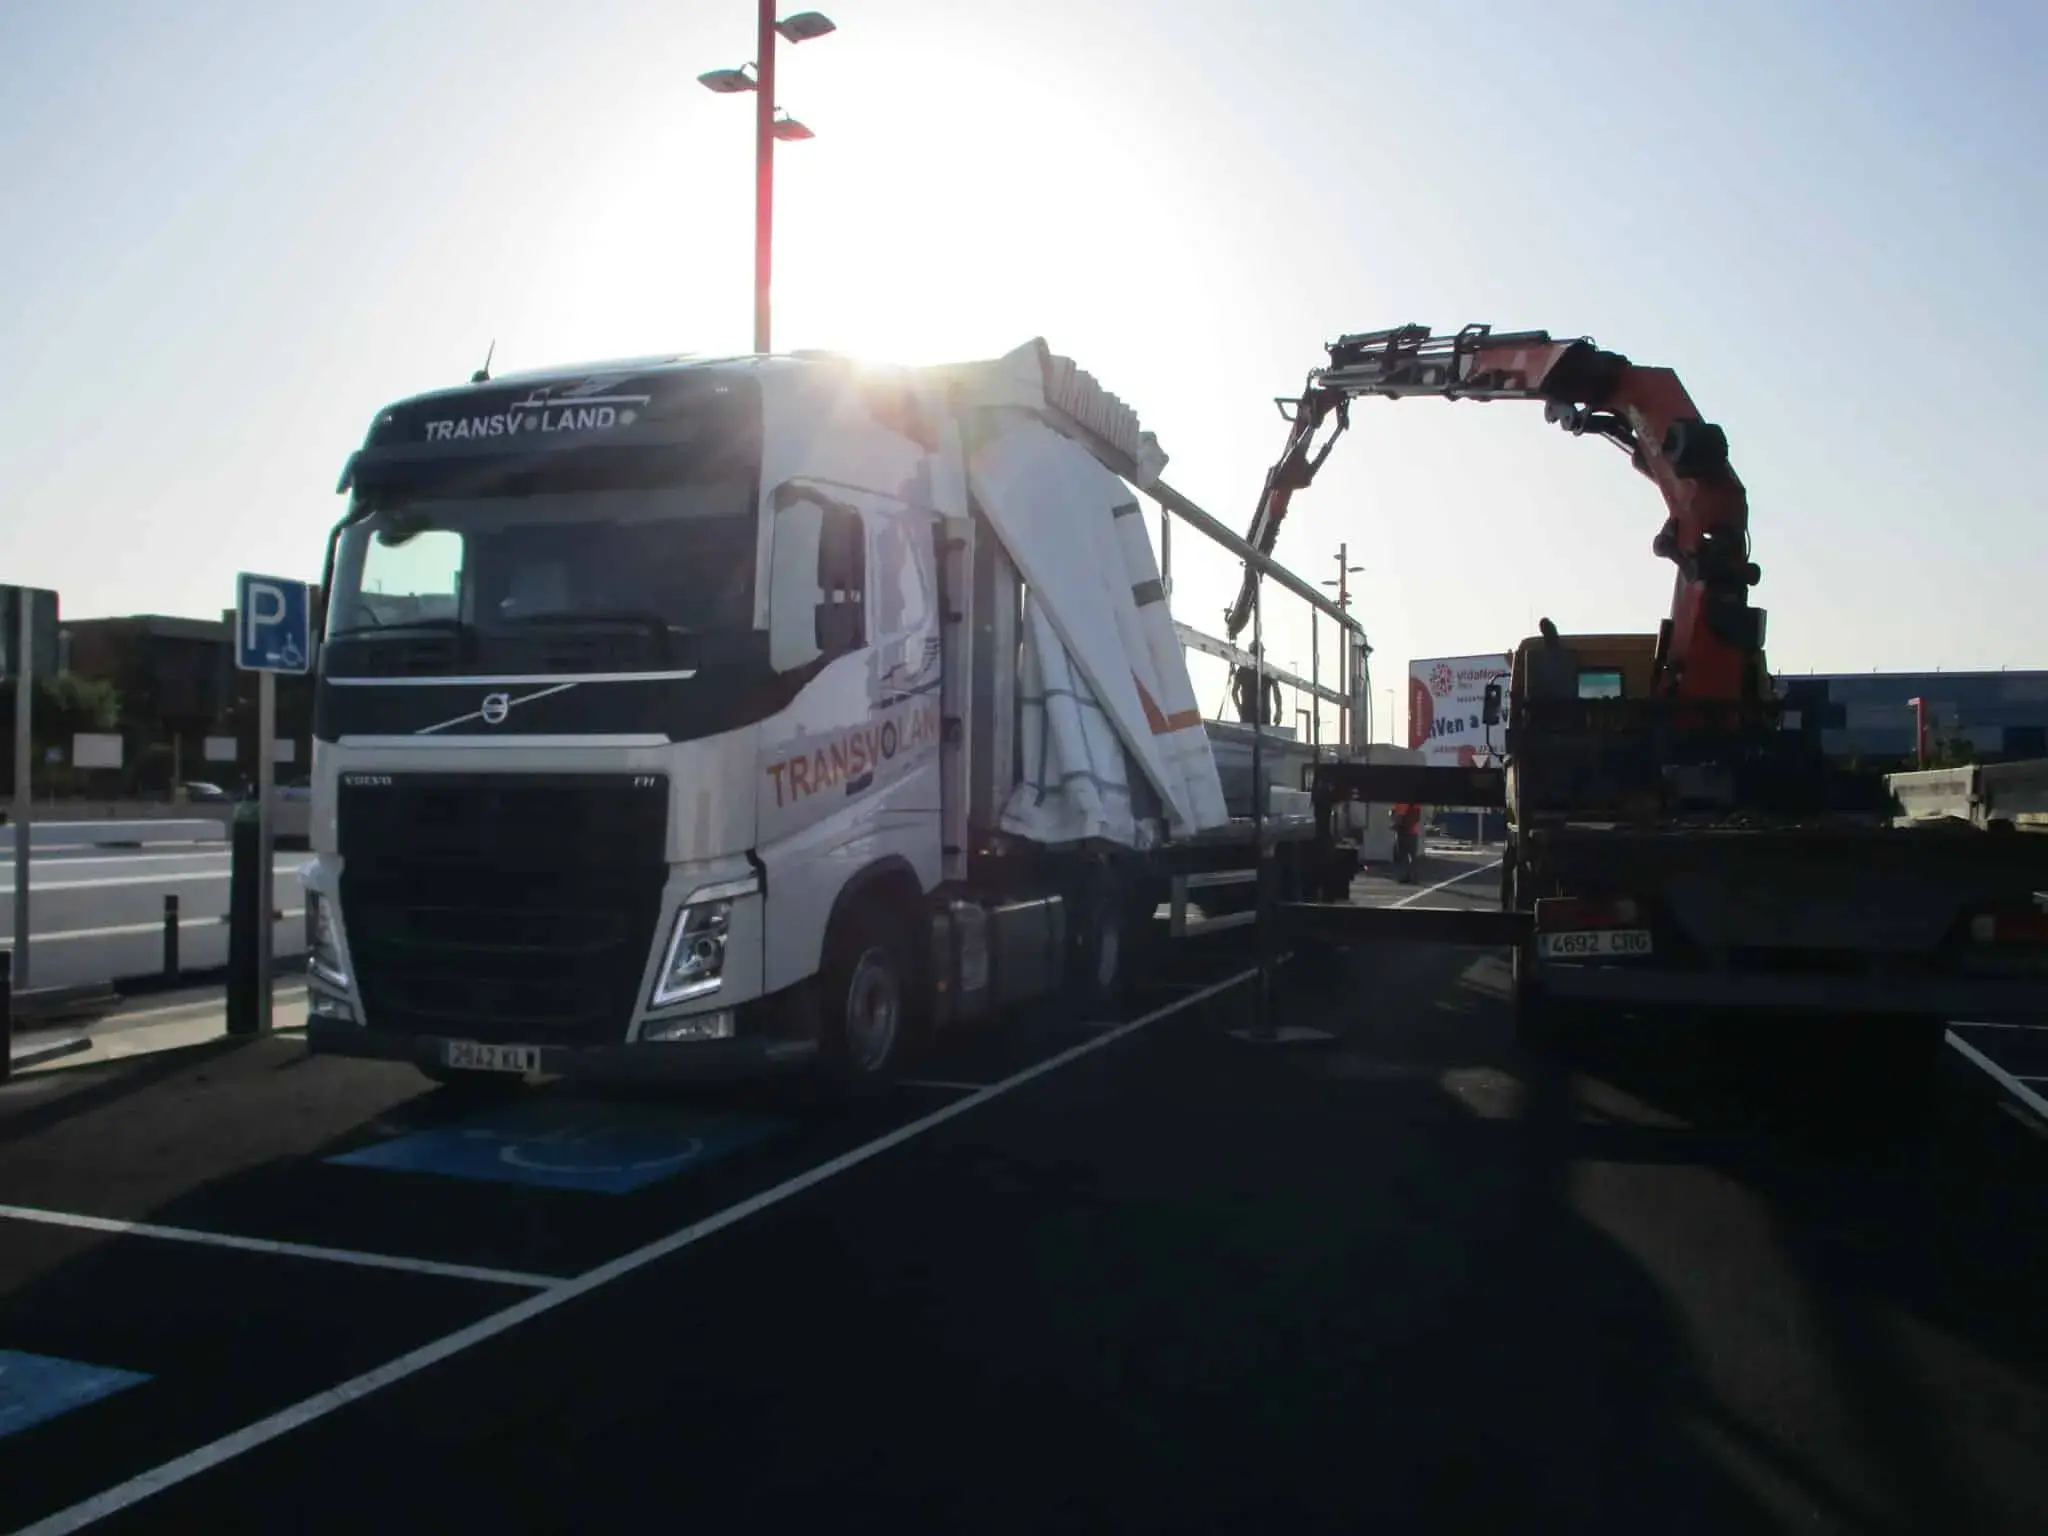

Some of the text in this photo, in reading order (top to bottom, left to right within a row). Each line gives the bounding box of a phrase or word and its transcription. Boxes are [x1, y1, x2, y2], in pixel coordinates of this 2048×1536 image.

[247, 582, 286, 651] P
[1470, 715, 1479, 729] a
[1552, 935, 1599, 952] 4692
